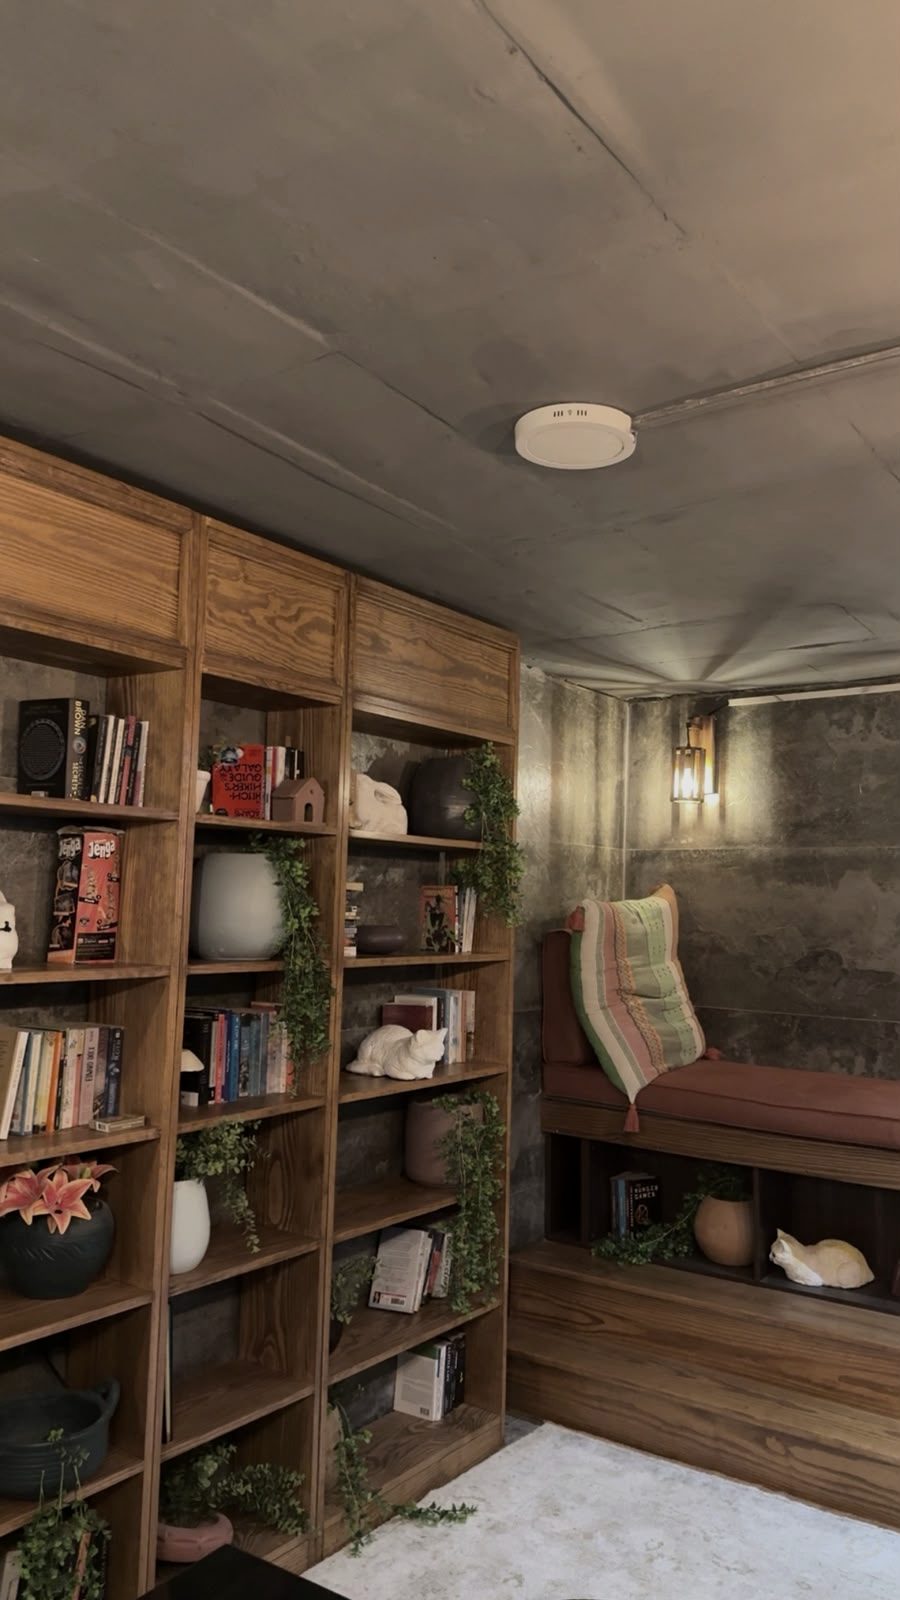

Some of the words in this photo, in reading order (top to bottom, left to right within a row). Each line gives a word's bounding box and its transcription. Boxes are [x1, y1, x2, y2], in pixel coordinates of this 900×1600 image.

[74, 700, 82, 736] BROWN
[219, 763, 262, 773] GALAXY
[229, 773, 262, 782] GUIDE
[224, 782, 262, 791] HIKER'S
[59, 837, 82, 858] Jenga
[88, 839, 116, 859] Jenga
